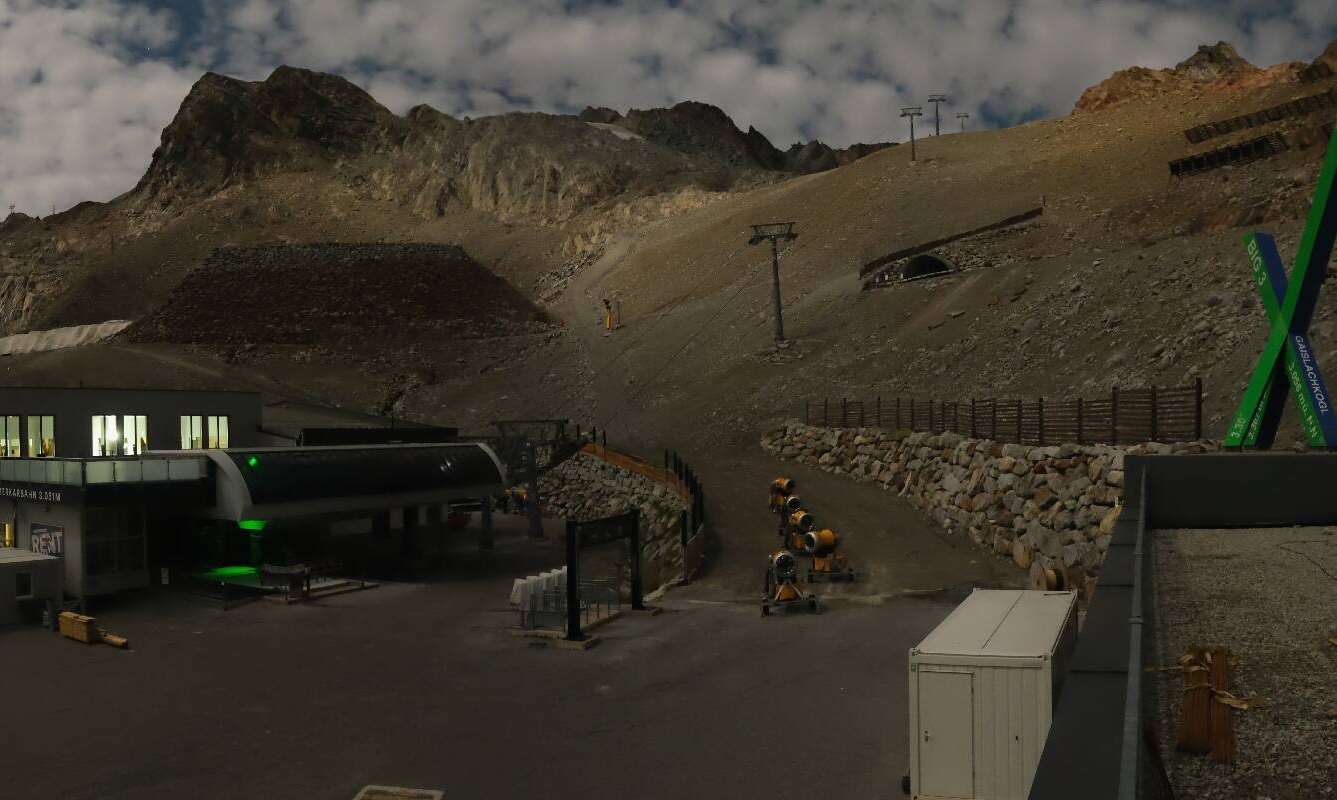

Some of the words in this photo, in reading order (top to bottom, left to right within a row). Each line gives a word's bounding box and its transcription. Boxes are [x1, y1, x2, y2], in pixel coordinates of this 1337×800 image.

[1247, 239, 1261, 272] BIG
[1258, 272, 1267, 286] 3
[1295, 335, 1329, 415] GAISLACHKOGL
